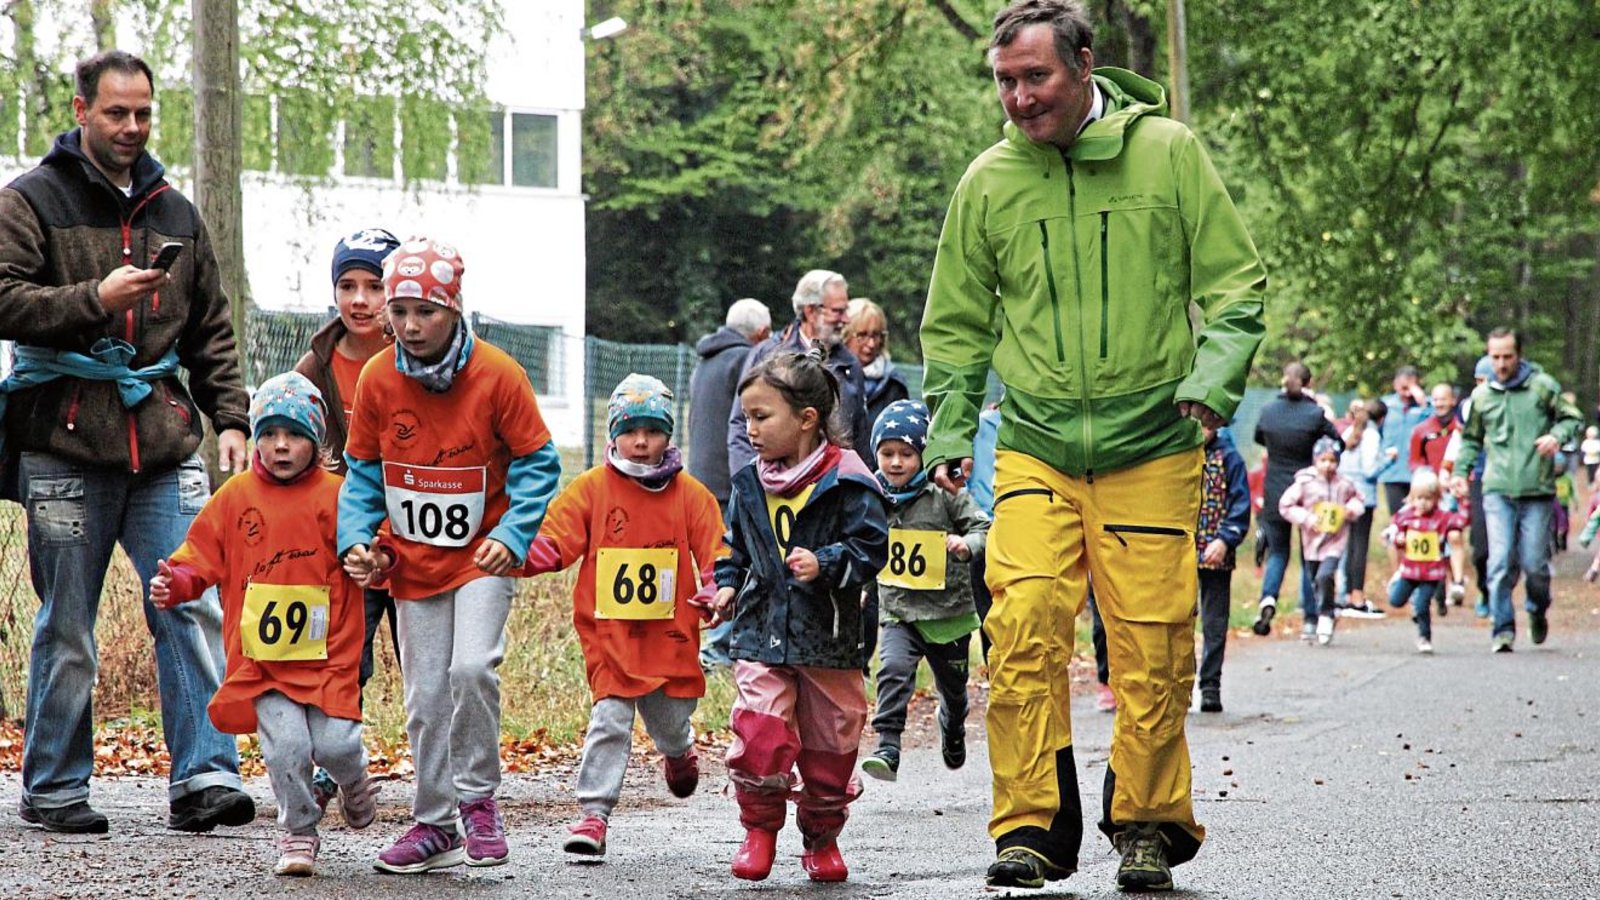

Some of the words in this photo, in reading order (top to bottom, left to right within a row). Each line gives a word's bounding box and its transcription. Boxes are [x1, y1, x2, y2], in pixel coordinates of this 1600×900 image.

[417, 478, 463, 489] Sparkasse
[401, 499, 470, 541] 108
[890, 541, 927, 577] 86
[1411, 538, 1431, 555] 90
[613, 562, 658, 605] 68
[258, 600, 308, 645] 69
